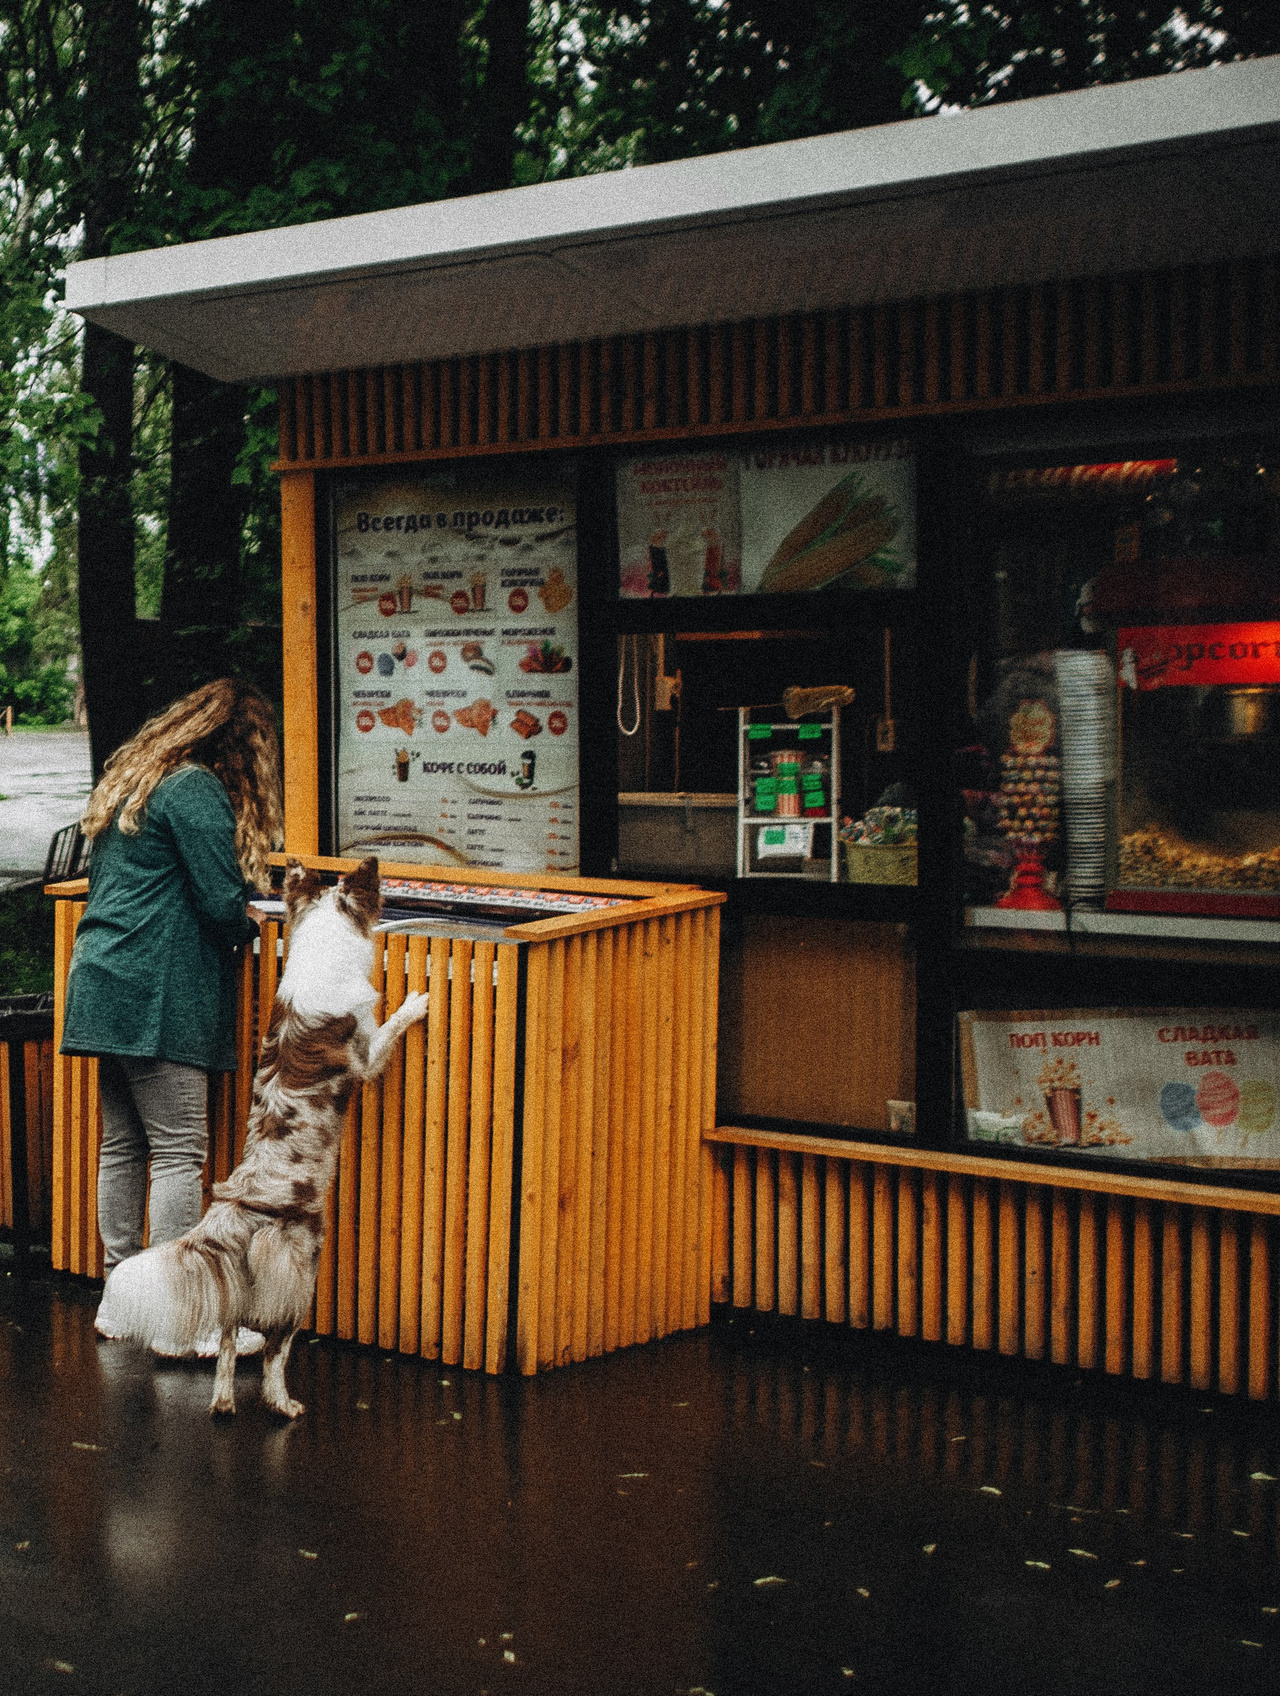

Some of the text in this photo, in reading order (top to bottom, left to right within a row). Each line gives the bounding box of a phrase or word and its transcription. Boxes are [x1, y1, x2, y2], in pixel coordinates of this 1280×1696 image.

[357, 506, 564, 533] Всегда в продаже:
[422, 759, 506, 775] КОФЕ С СОБОЙ
[1009, 1031, 1100, 1048] ПОП КОРН
[1157, 1025, 1260, 1044] СЛАДКАЯ
[1184, 1050, 1237, 1067] ВАТА
